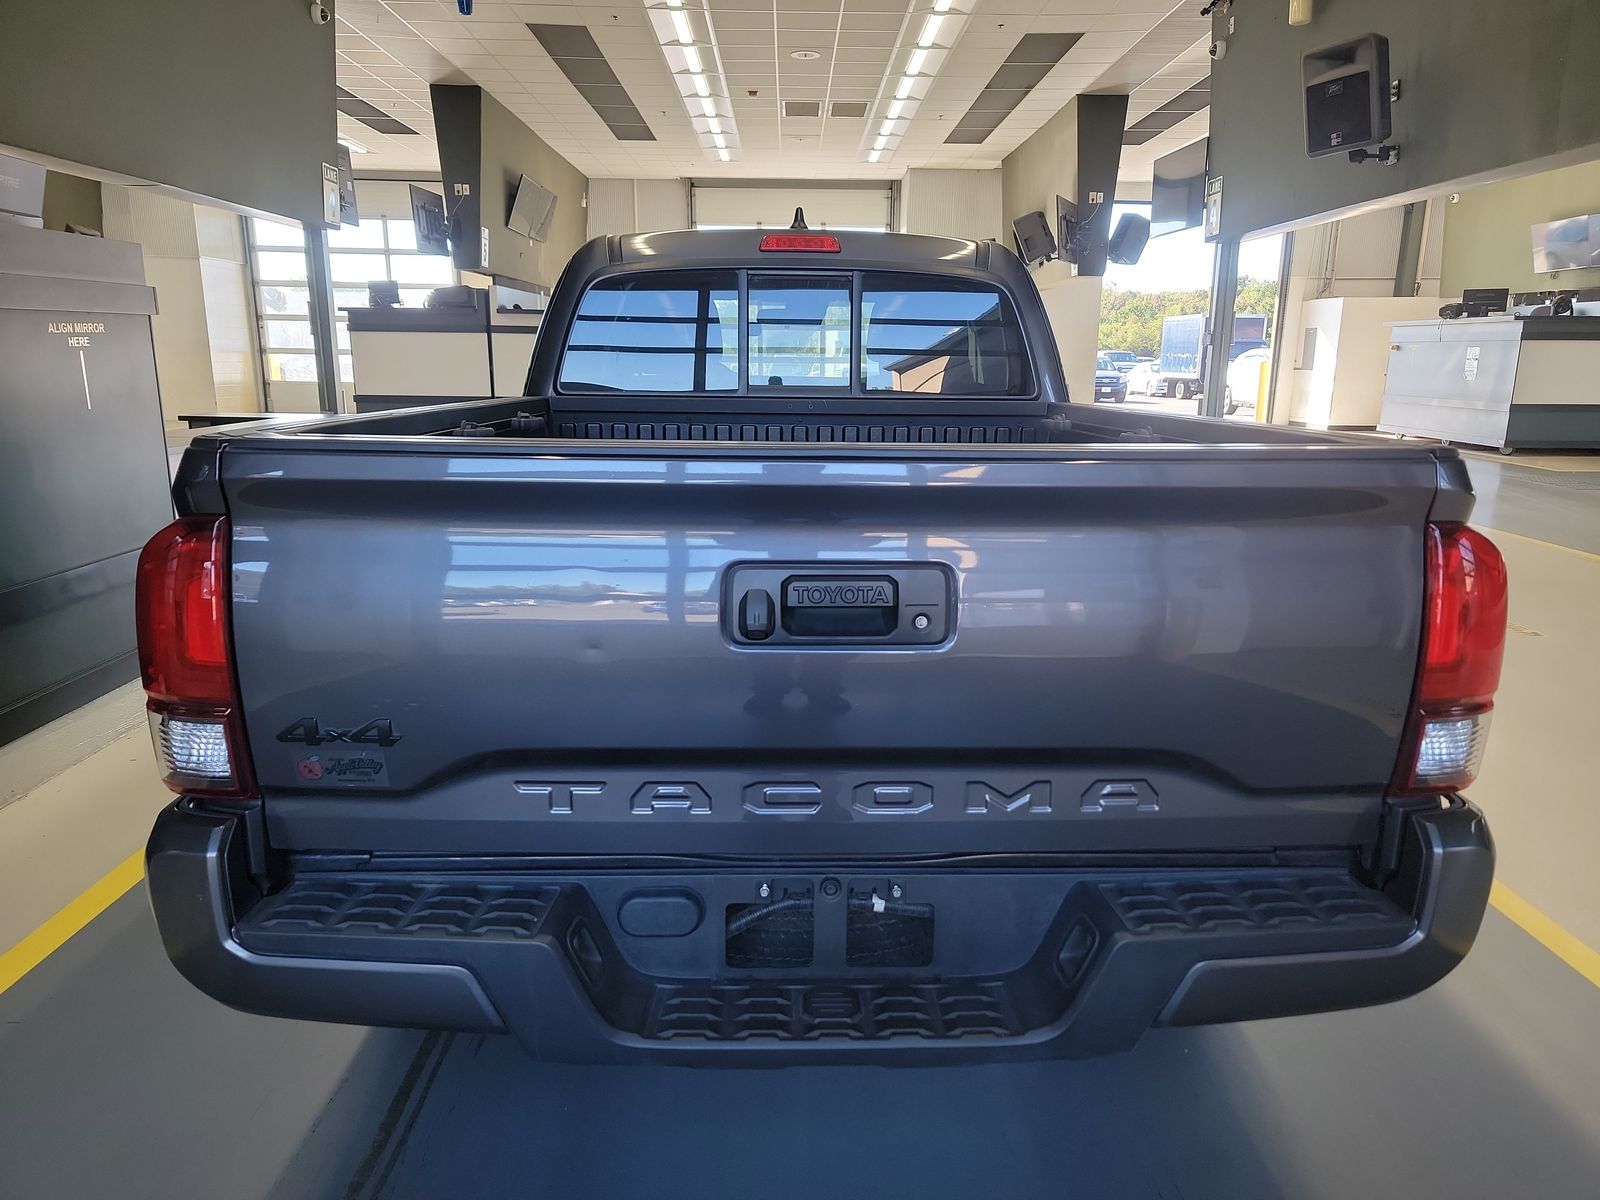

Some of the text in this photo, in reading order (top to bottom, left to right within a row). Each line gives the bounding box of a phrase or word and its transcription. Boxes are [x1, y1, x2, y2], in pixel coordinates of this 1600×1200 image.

[48, 322, 105, 333] ALIGN MIRROR
[68, 336, 91, 347] HERE
[793, 585, 889, 604] TOYOTA
[276, 717, 402, 747] 4x4
[513, 780, 1160, 814] TACOMA
